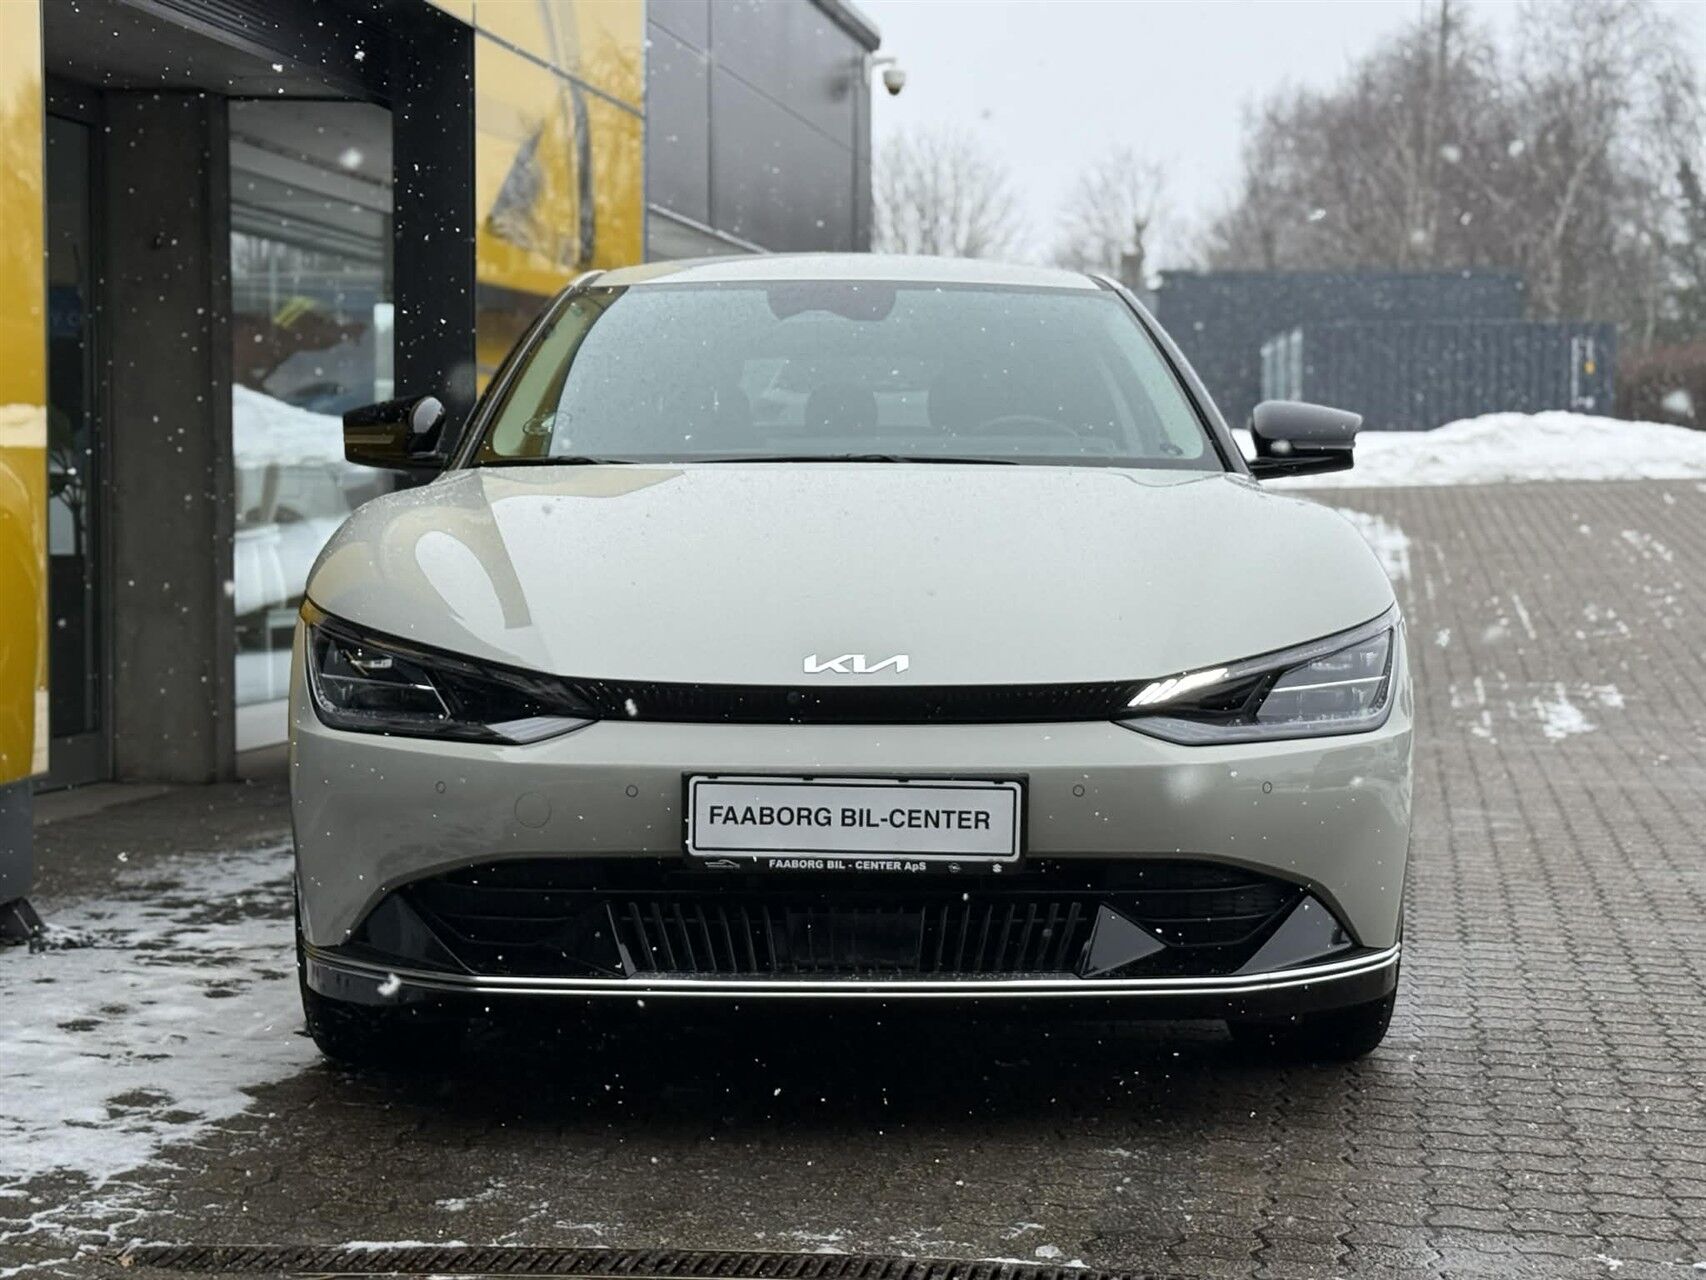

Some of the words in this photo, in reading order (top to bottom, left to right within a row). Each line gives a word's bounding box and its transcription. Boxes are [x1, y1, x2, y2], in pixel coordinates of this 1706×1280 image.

[803, 653, 909, 673] KIA
[709, 806, 832, 827] FAABORG
[840, 808, 991, 830] BIL-CENTER
[769, 859, 824, 869] FAABORG
[827, 860, 846, 870] BIL
[855, 860, 901, 870] CENTER
[904, 861, 927, 872] ApS
